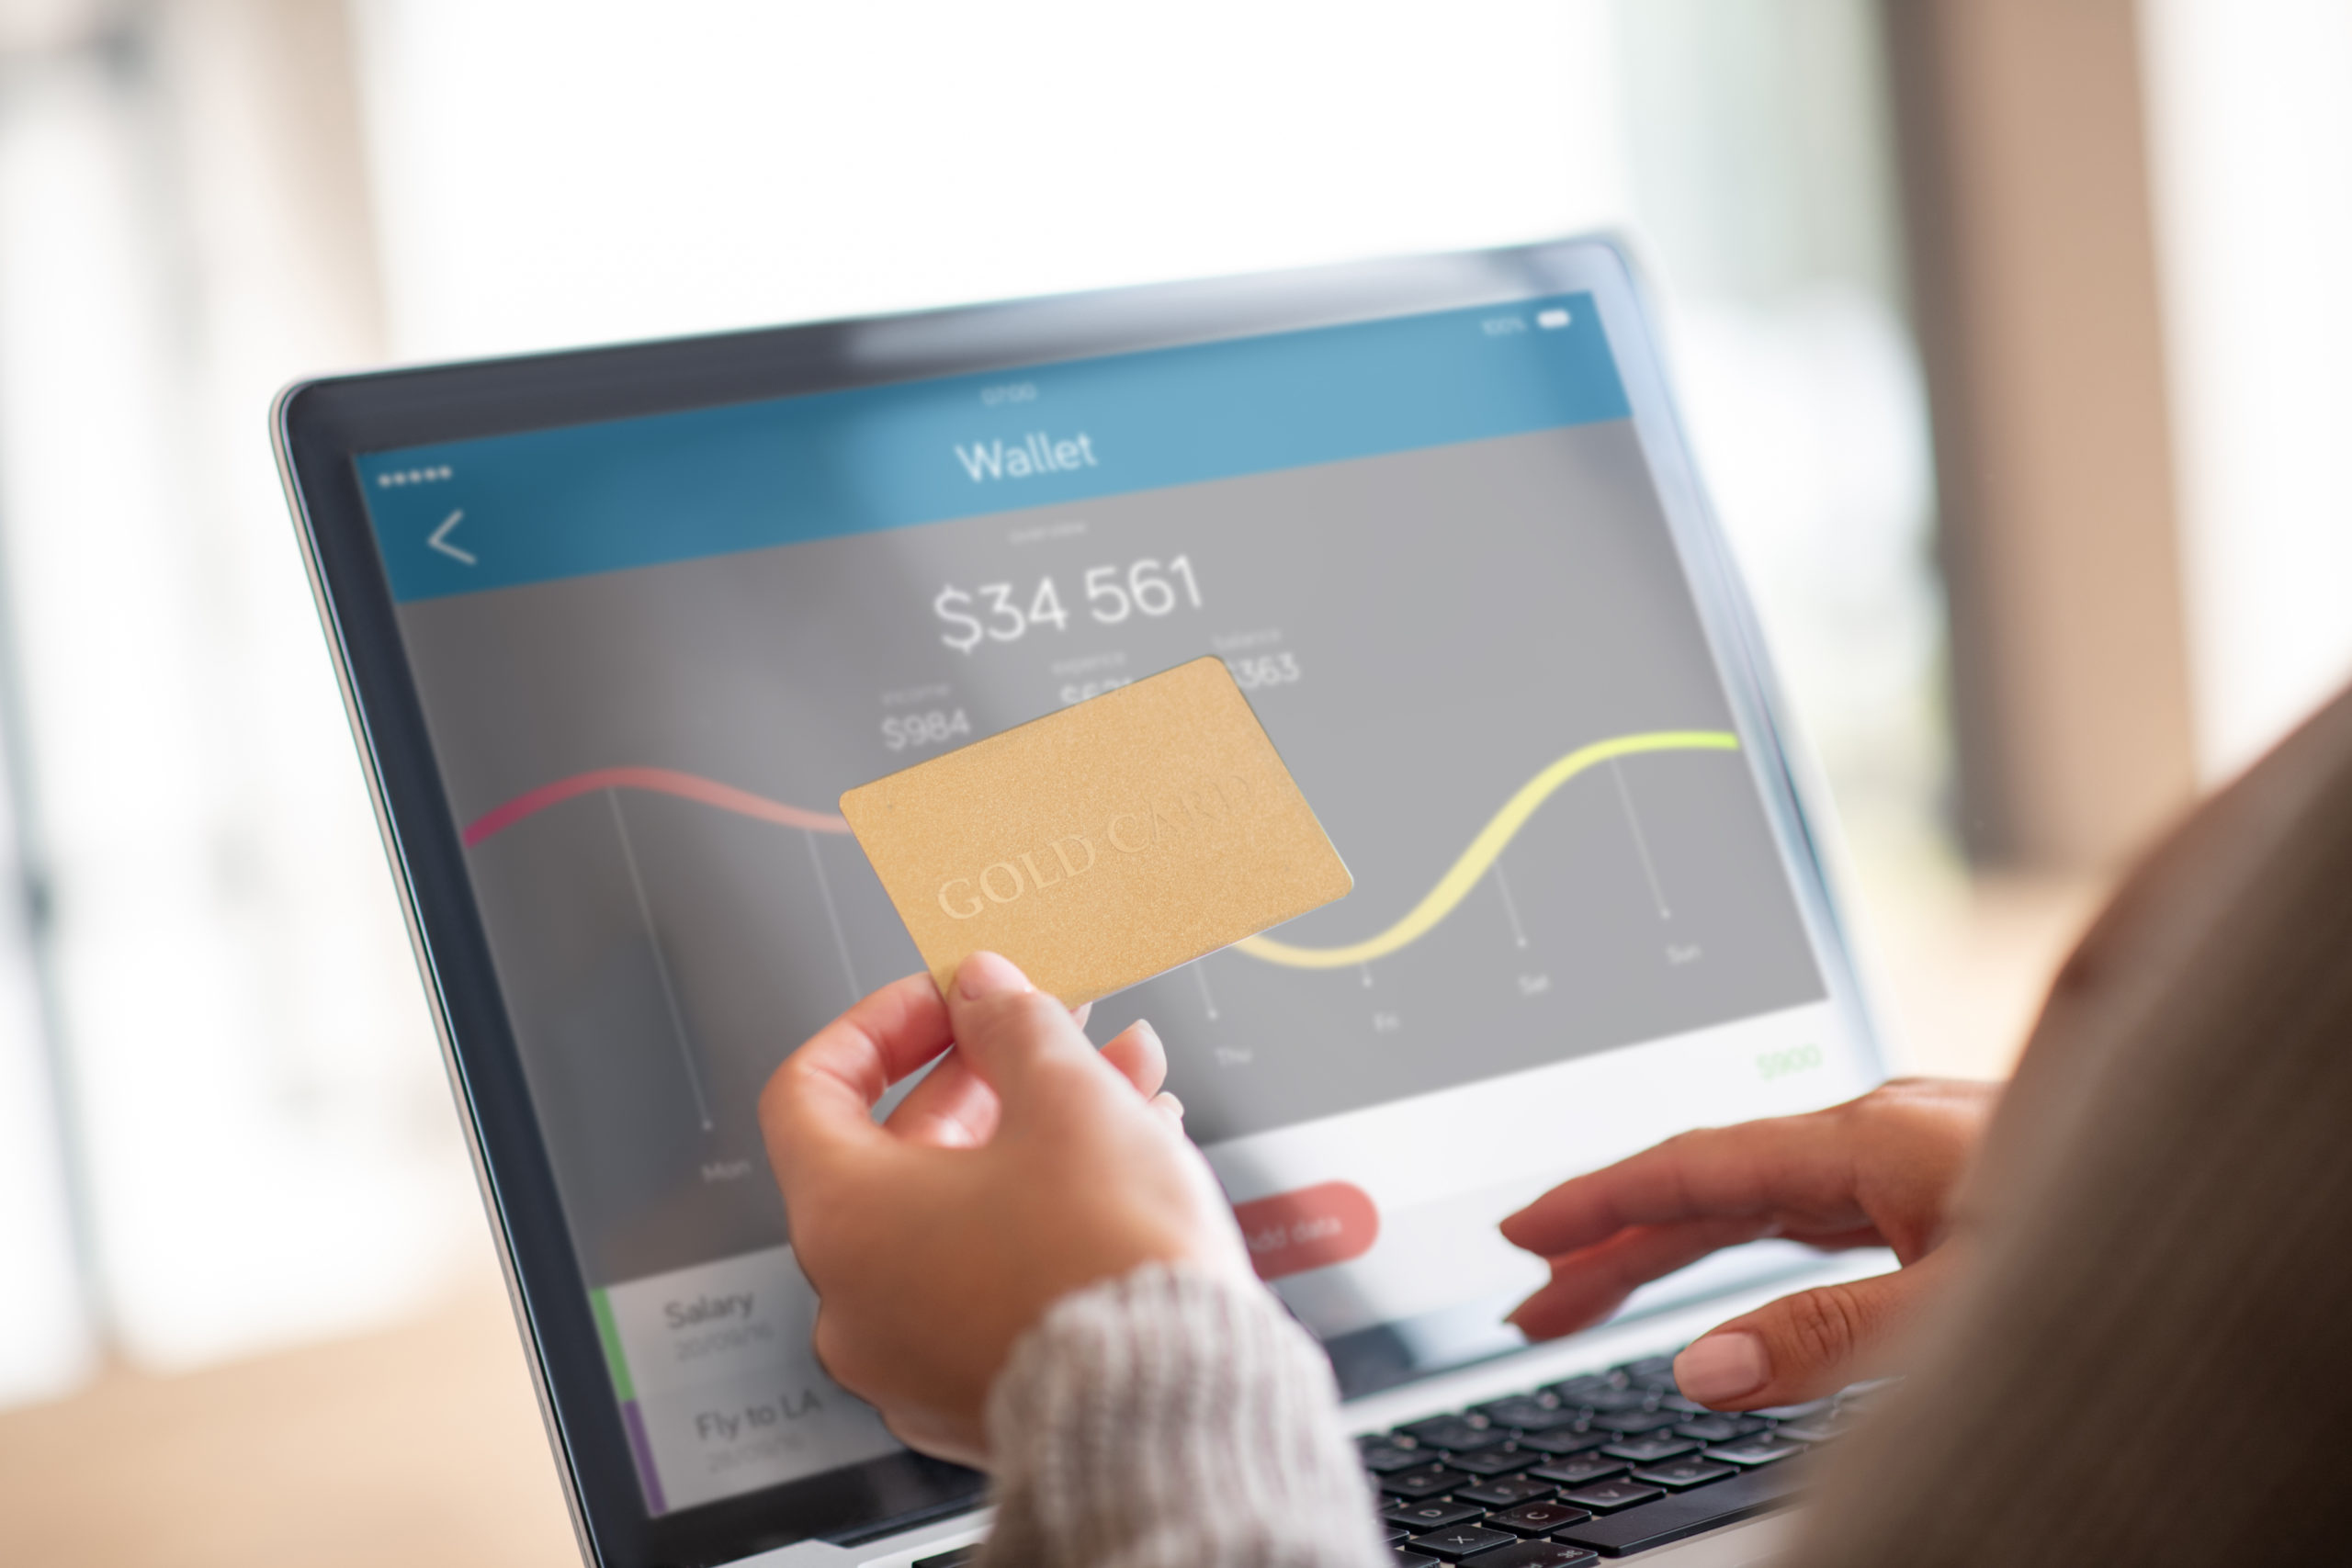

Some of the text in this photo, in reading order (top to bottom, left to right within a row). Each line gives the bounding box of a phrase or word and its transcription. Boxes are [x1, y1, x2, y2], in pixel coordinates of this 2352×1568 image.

[956, 432, 1098, 482] Wallet
[933, 555, 1203, 655] $34 561
[882, 708, 970, 750] $984
[936, 773, 1257, 919] GOLD CARD
[1756, 1043, 1823, 1081] $900
[664, 1292, 753, 1330] Salary
[695, 1389, 823, 1441] Fly to LA
